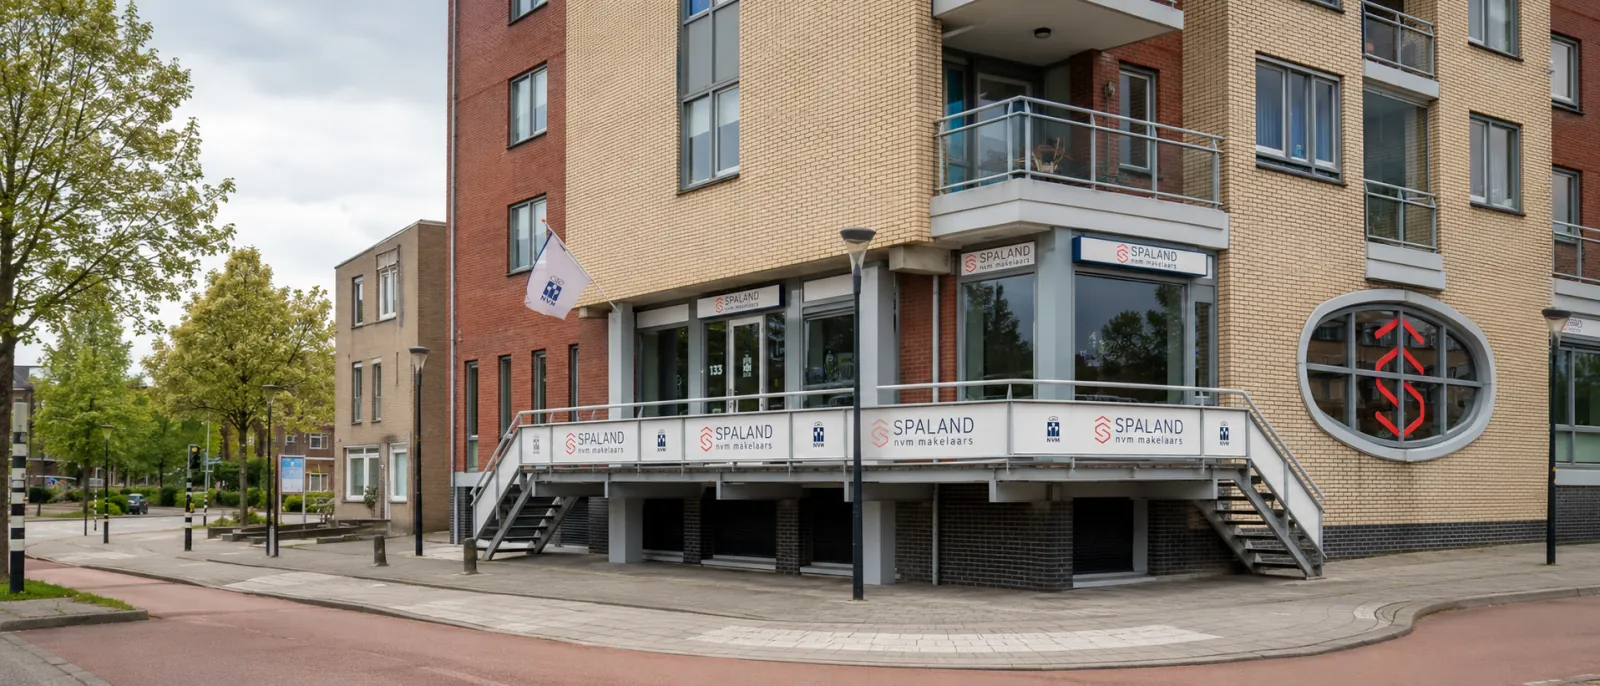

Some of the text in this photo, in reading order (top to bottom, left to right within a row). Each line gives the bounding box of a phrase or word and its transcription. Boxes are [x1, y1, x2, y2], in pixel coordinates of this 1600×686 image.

[980, 246, 1031, 263] SPALAND
[1131, 246, 1177, 261] SPALAND
[725, 291, 759, 306] SPALAND
[709, 364, 723, 376] 133
[715, 424, 773, 441] SPALAND
[893, 417, 974, 436] SPALAND
[1115, 417, 1184, 434] SPALAND
[578, 431, 625, 446] SPALAND
[733, 441, 773, 450] makelaars
[918, 436, 973, 446] makelaars
[1115, 436, 1183, 445] nvm makelaars
[592, 446, 624, 454] makelaars
